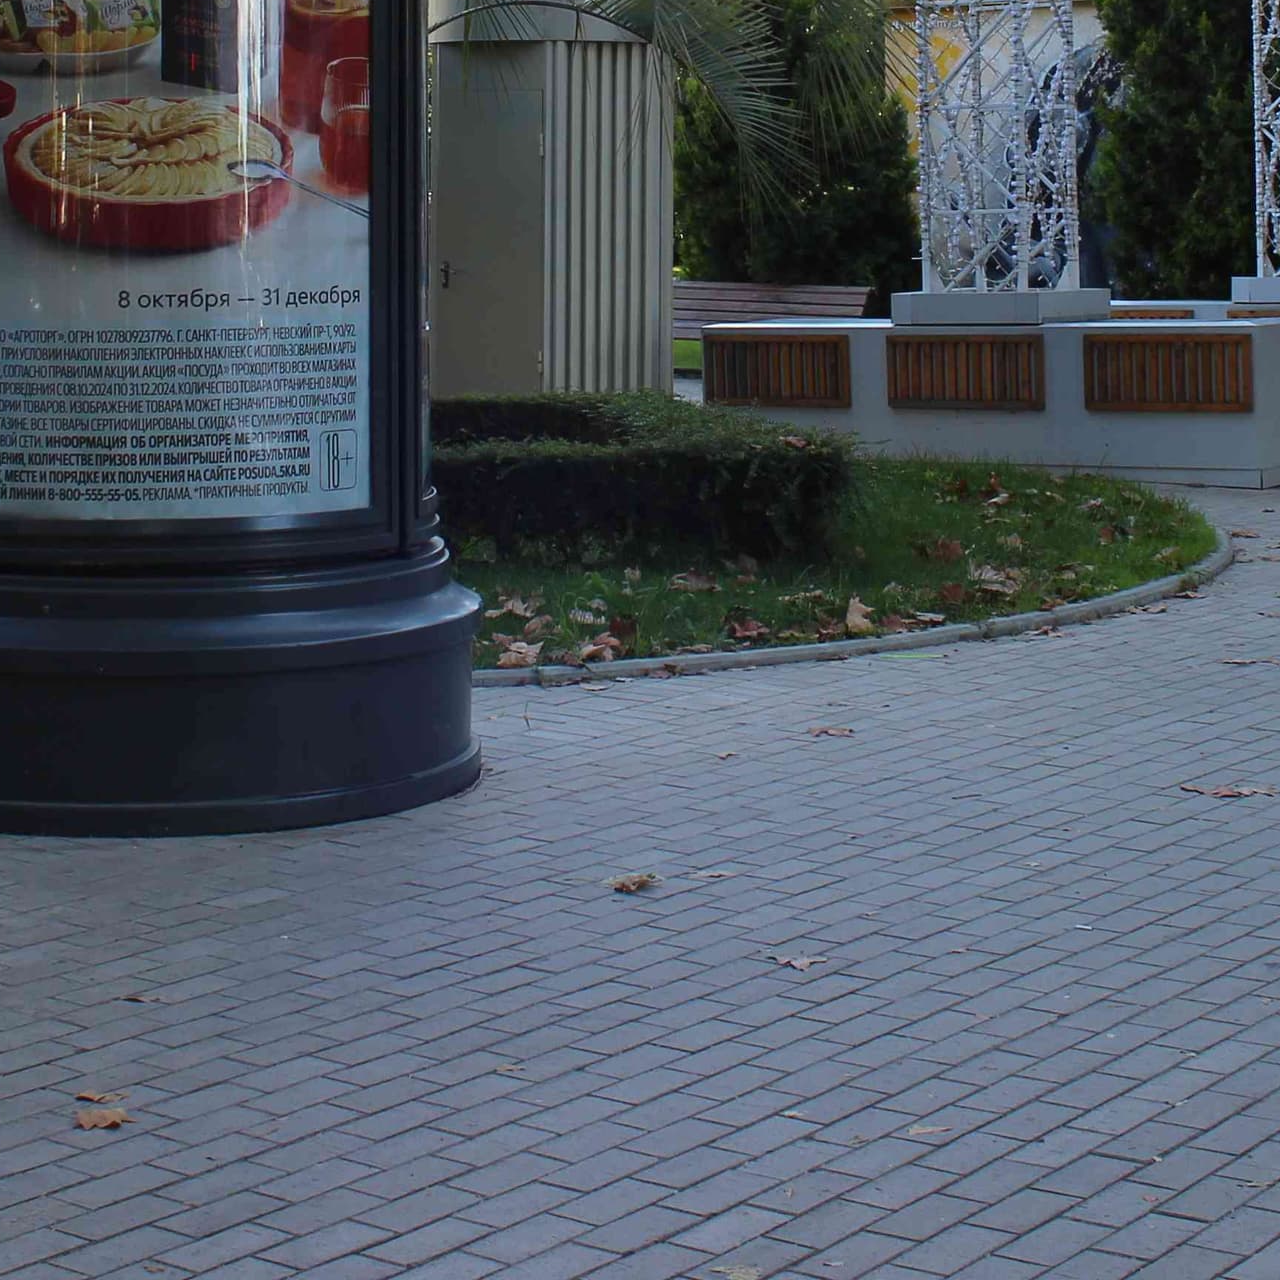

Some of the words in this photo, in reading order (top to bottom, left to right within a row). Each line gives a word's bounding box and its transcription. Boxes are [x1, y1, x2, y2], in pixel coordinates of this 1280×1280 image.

[117, 289, 131, 309] 8
[137, 288, 231, 312] октября
[261, 288, 280, 306] 31
[285, 285, 361, 308] декабря
[68, 330, 94, 343] ОГРН
[273, 324, 312, 340] НЕВСКИЙ
[64, 347, 130, 361] НАКОПЛЕНИЯ
[131, 346, 203, 361] ЭЛЕКТРОННЫХ
[205, 345, 246, 359] НАКЛЕЕК
[254, 342, 332, 358] ИСПОЛЬЗОВАНИЕМ
[332, 341, 357, 355] КАРТЫ
[3, 364, 47, 378] СОГЛАСНО
[47, 365, 103, 378] ПРАВИЛАМ
[142, 364, 176, 380] АКЦИЯ
[177, 364, 229, 379] «ПОСУДА»
[231, 361, 278, 377] ПРОХОДИТ
[292, 360, 311, 374] ВСЕХ
[312, 358, 357, 373] МАГАЗИНАХ
[178, 381, 238, 397] КОЛИЧЕСТВО
[70, 400, 145, 414] ИЗОБРАЖЕНИЕ
[146, 400, 184, 414] ТОВАРА
[185, 398, 221, 413] МОЖЕТ
[223, 395, 297, 412] НЕЗНАЧИТЕЛЬНО
[299, 392, 347, 408] ОТЛИЧАТЬСЯ
[30, 417, 49, 431] ВСЕ
[50, 417, 89, 431] ТОВАРЫ
[197, 416, 237, 431] СКИДКА
[238, 415, 251, 428] НЕ
[251, 412, 313, 428] СУММИРУЕТСЯ
[45, 436, 127, 451] ИНФОРМАЦИЯ
[130, 436, 146, 449] ОБ
[148, 433, 231, 448] ОРГАНИЗАТОРЕ
[28, 453, 94, 467] КОЛИЧЕСТВЕ
[95, 453, 138, 467] ПРИЗОВ
[139, 453, 162, 466] ИЛИ
[163, 448, 232, 466] ВЫИГРЫШЕЙ
[233, 450, 249, 463] ПО
[249, 446, 311, 462] РЕЗУЛЬТАТАМ
[326, 432, 354, 490] 18+
[4, 470, 41, 483] МЕСТЕ
[49, 470, 101, 486] ПОРЯДКЕ
[101, 470, 116, 484] ИХ
[117, 469, 185, 484] ПОЛУЧЕНИЯ
[186, 469, 203, 483] НА
[203, 465, 237, 482] САЙТЕ
[237, 463, 311, 481] POSUDA.5KA.RU
[8, 486, 47, 500] ЛИНИИ
